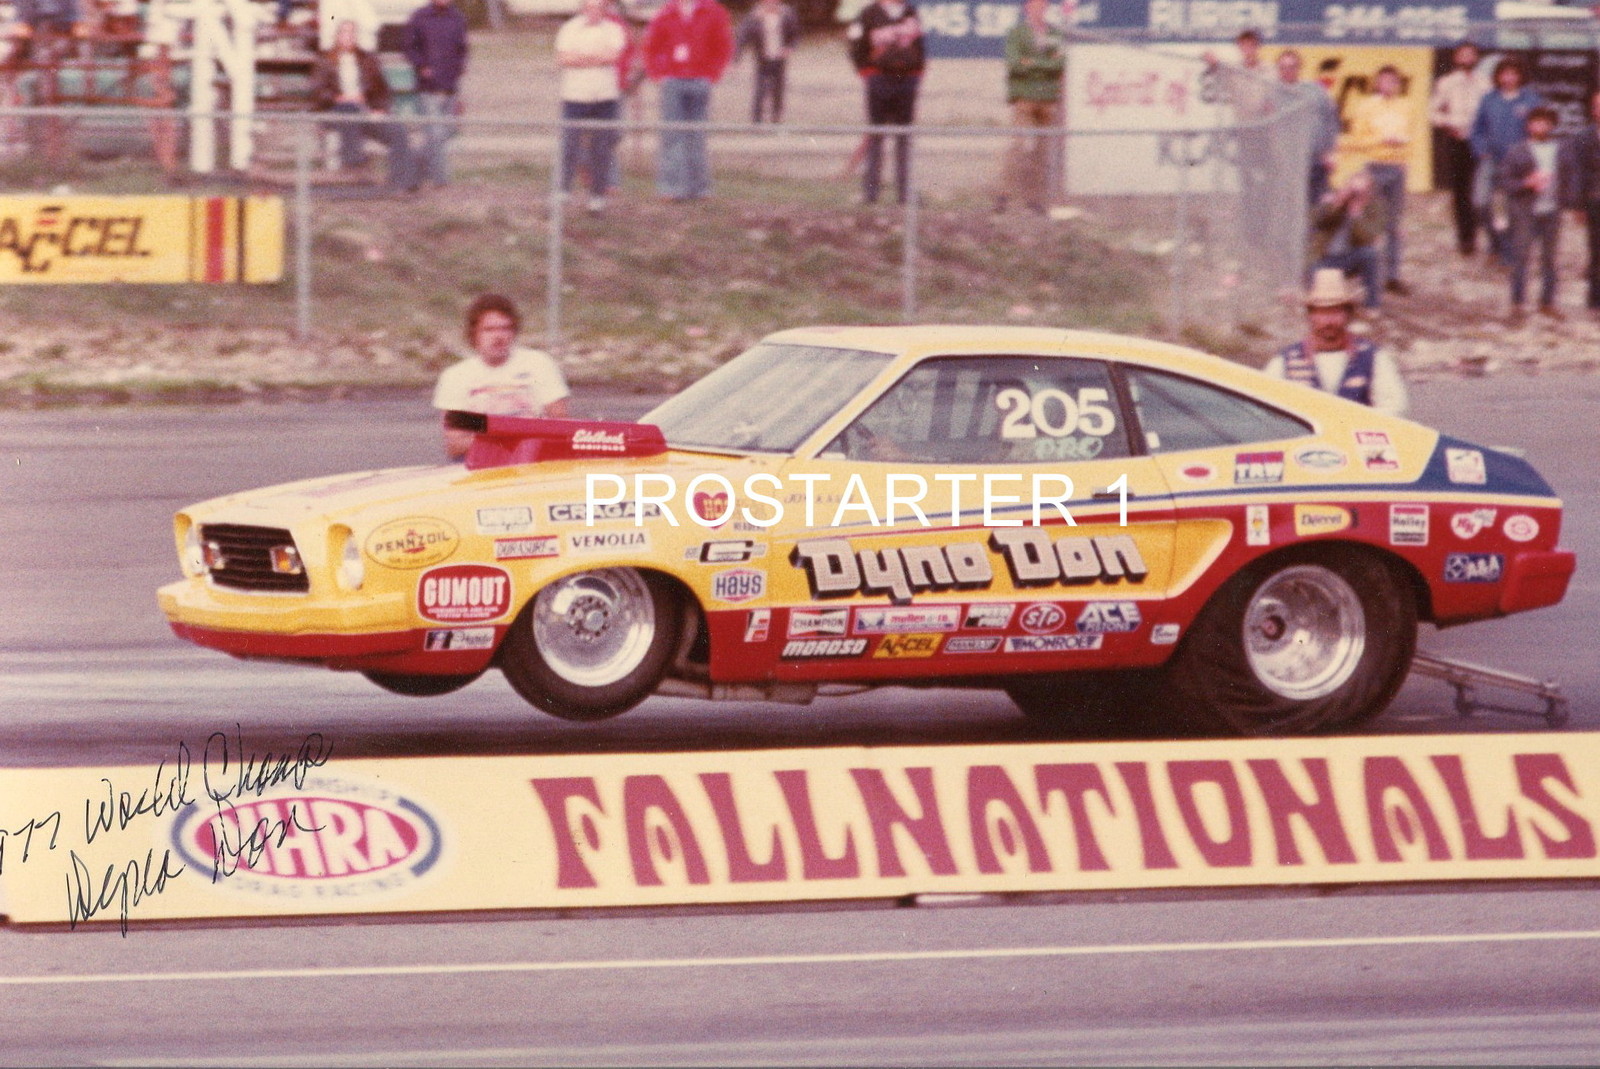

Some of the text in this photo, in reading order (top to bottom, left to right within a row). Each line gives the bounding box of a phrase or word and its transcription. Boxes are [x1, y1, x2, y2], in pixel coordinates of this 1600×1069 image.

[996, 388, 1115, 438] 205
[375, 531, 451, 554] PENNZOIL
[572, 532, 646, 548] VENOLIA
[788, 527, 1149, 606] Dyno Don
[424, 576, 507, 606] GUMOUT
[793, 615, 845, 628] CHAMPION
[1026, 607, 1061, 628] STP
[1082, 602, 1140, 624] ACE
[1021, 636, 1088, 651] MONROE
[202, 801, 409, 878] NHRA
